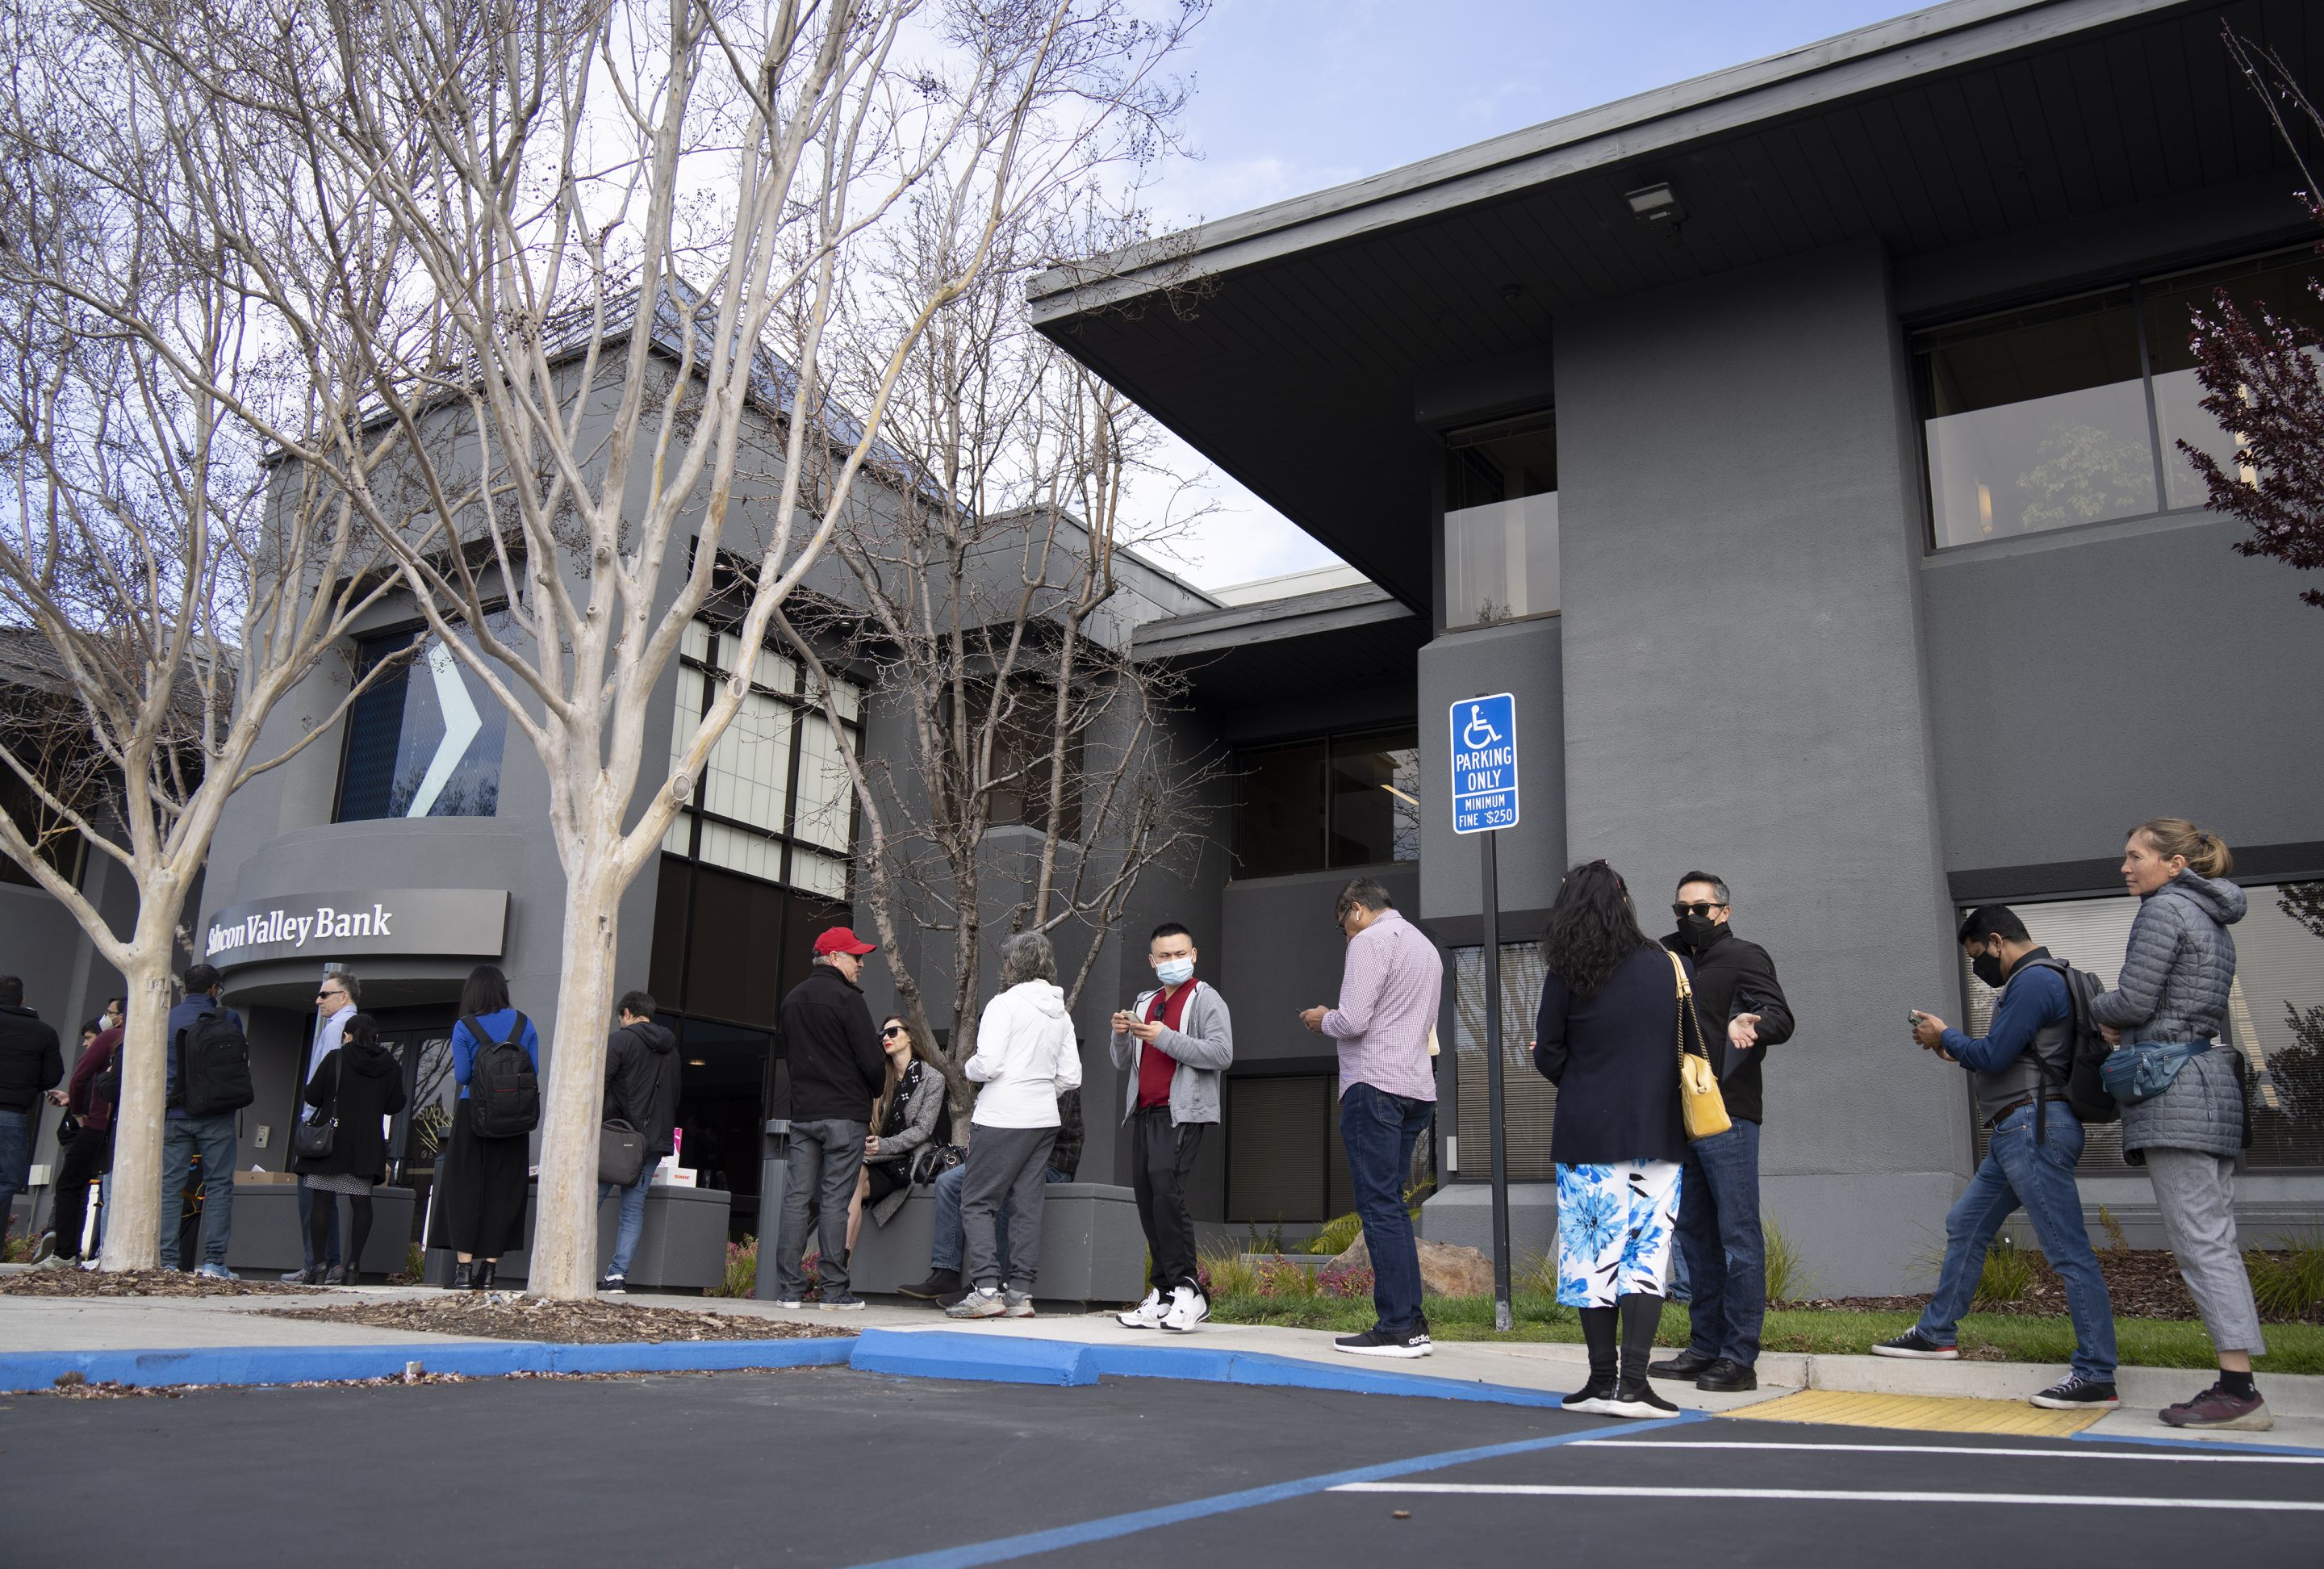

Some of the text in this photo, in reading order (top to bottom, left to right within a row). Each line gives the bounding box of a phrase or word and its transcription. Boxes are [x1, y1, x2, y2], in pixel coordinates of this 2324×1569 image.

[1457, 747, 1511, 772] PARKING
[1468, 769, 1502, 791] ONLY
[1465, 794, 1505, 811] MINIMUM
[1459, 809, 1512, 828] FINE $250
[247, 910, 314, 948] Valley
[314, 904, 392, 938] Bank
